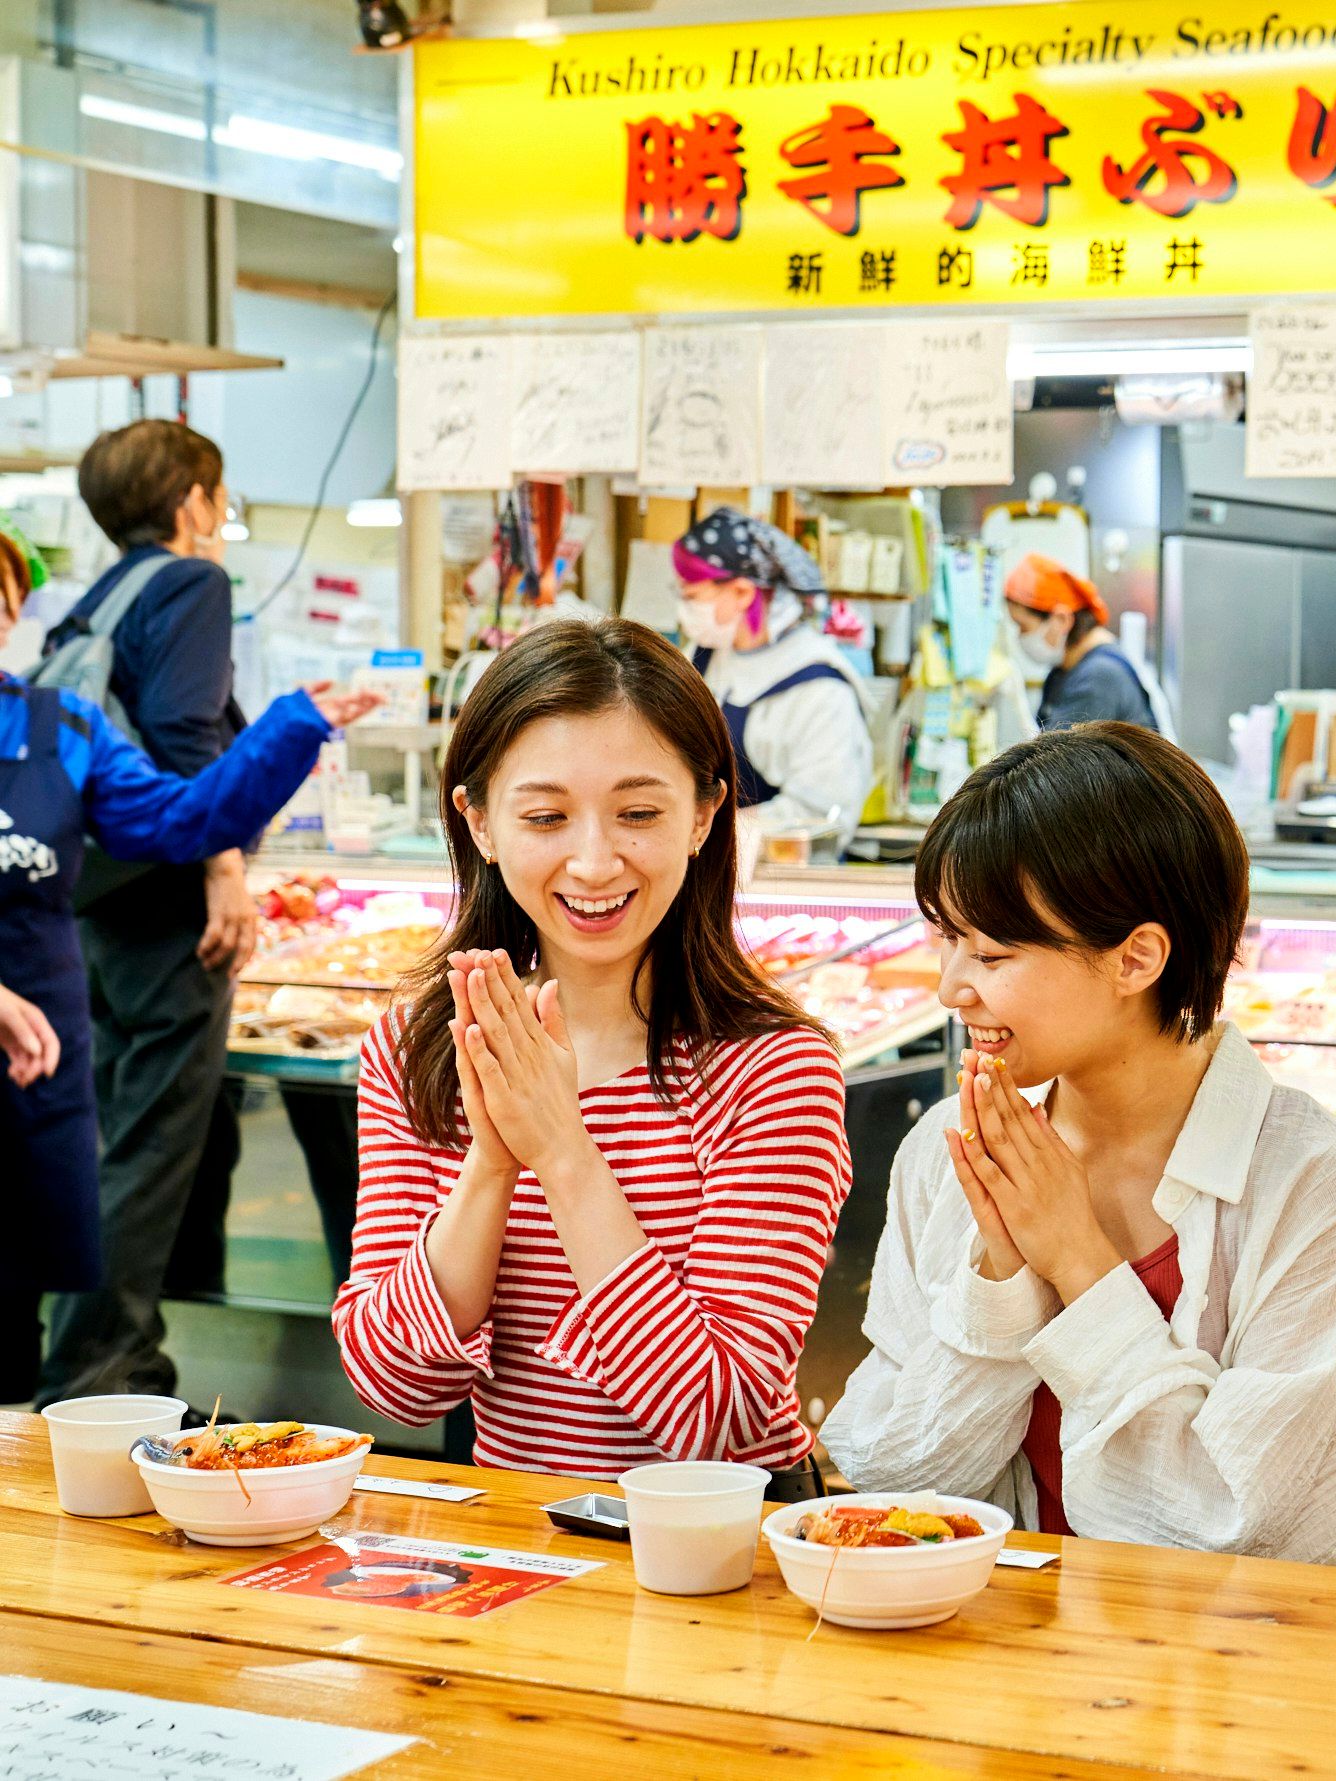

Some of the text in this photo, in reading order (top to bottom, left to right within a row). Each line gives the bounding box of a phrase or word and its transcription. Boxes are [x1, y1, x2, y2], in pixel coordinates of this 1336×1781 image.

[547, 53, 706, 99] Kushiro
[724, 40, 930, 88] Hokkaido
[954, 22, 1157, 82] Specialty
[787, 236, 1203, 296] 新鮮的海鮮丼
